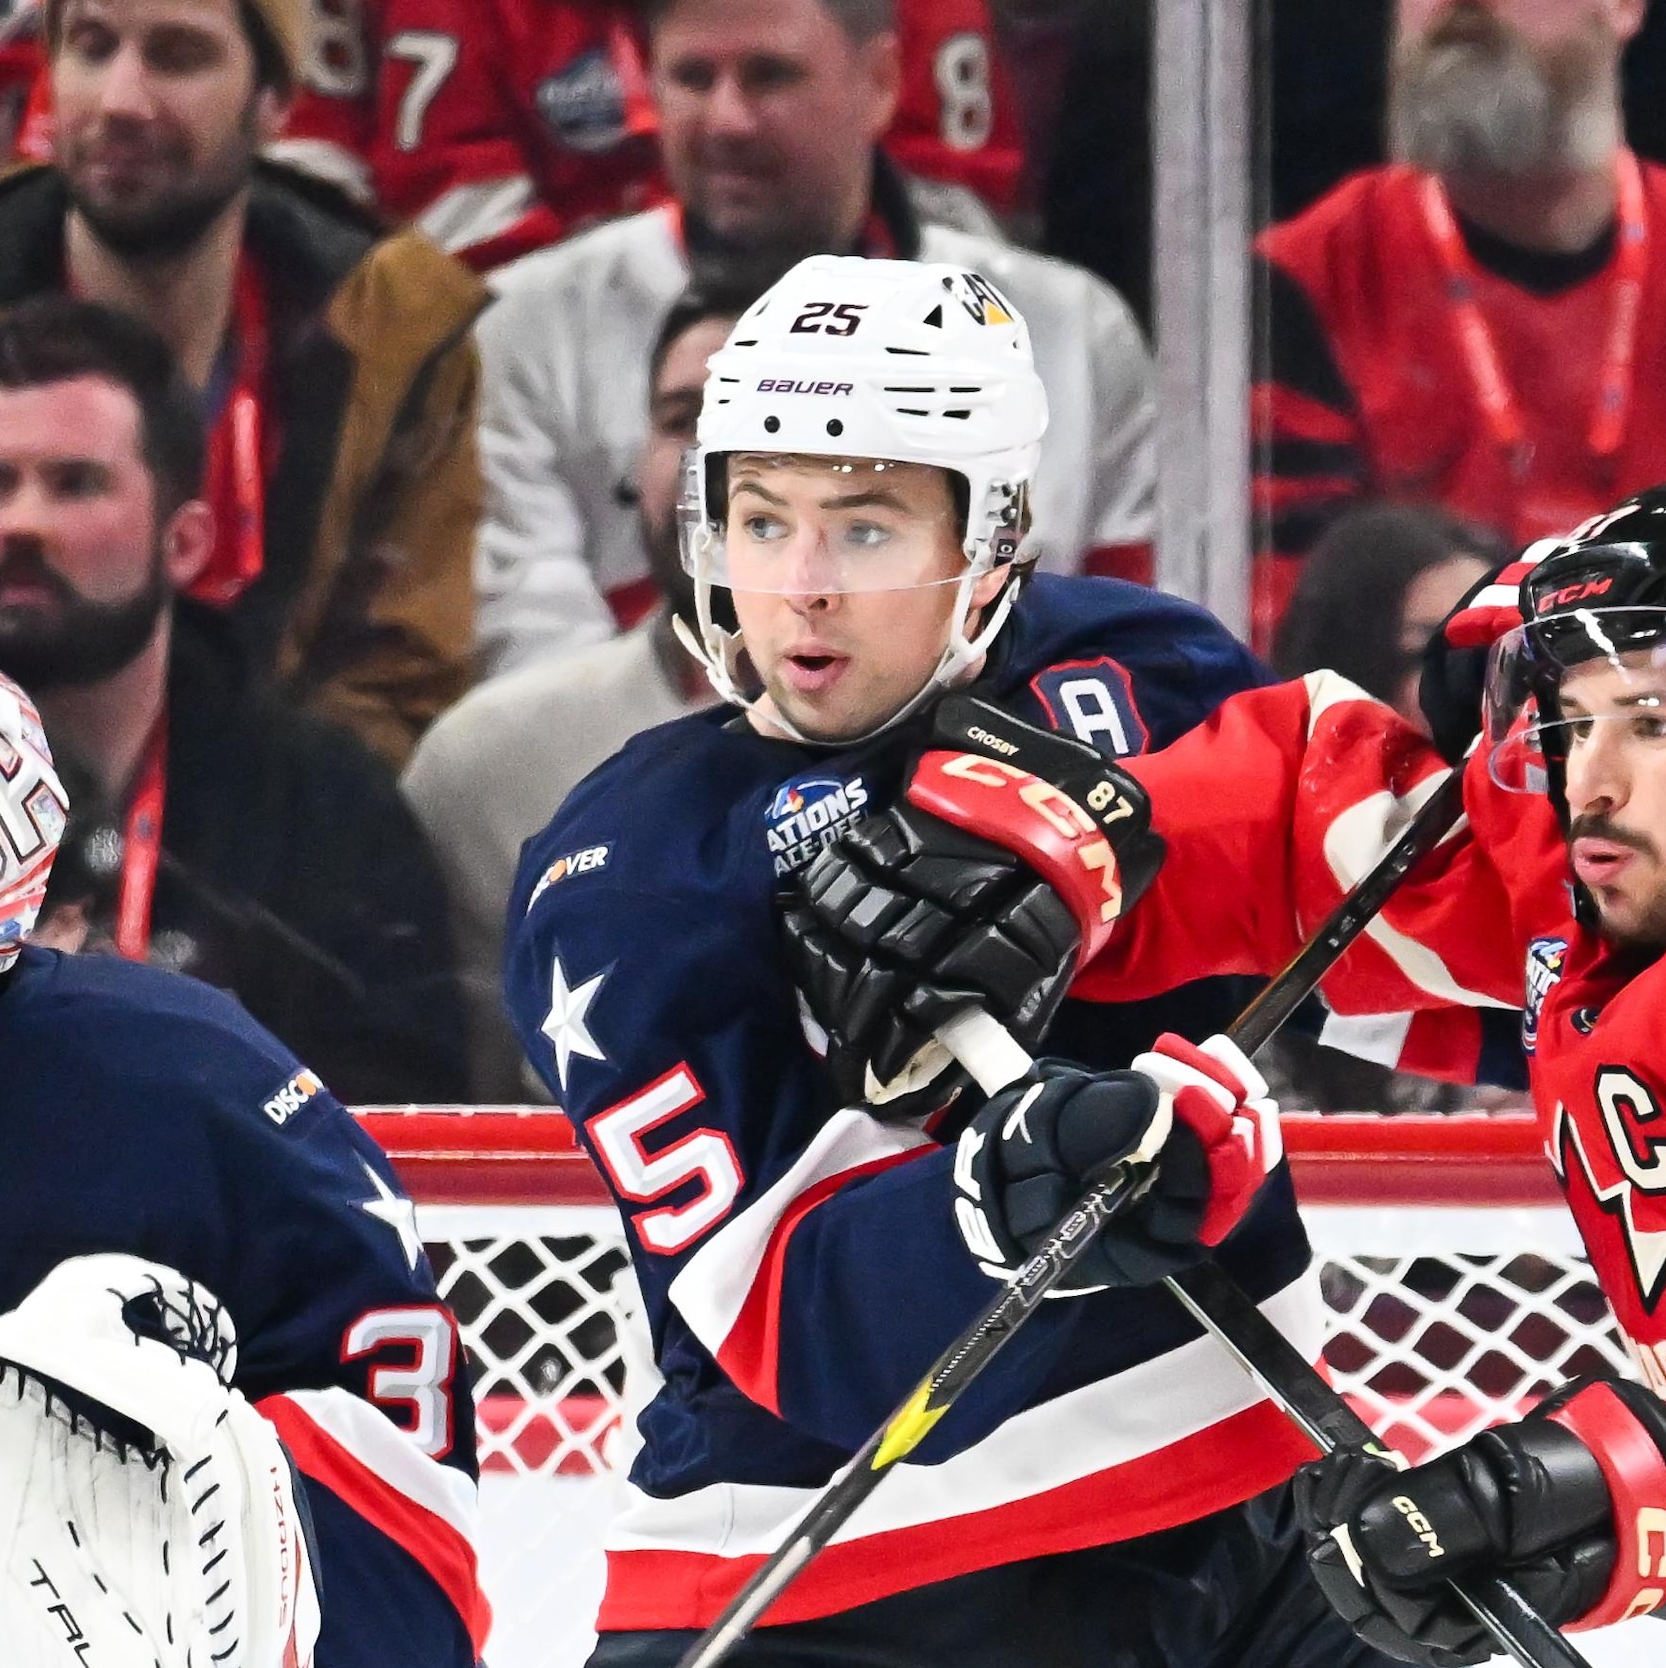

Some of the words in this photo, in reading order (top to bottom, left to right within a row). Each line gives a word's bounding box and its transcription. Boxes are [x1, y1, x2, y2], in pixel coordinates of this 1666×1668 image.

[388, 32, 458, 151] 7
[935, 34, 991, 151] 8
[790, 302, 869, 336] 25
[756, 379, 854, 396] BAUER
[1537, 577, 1613, 613] CCM
[967, 725, 1020, 756] CROSBY
[1059, 678, 1130, 755] A
[767, 778, 868, 852] ATIONS
[941, 753, 1123, 923] CCM
[1086, 781, 1134, 824] 87
[586, 1061, 745, 1256] 5
[342, 1302, 459, 1462] 3
[1393, 1496, 1445, 1557] CCM
